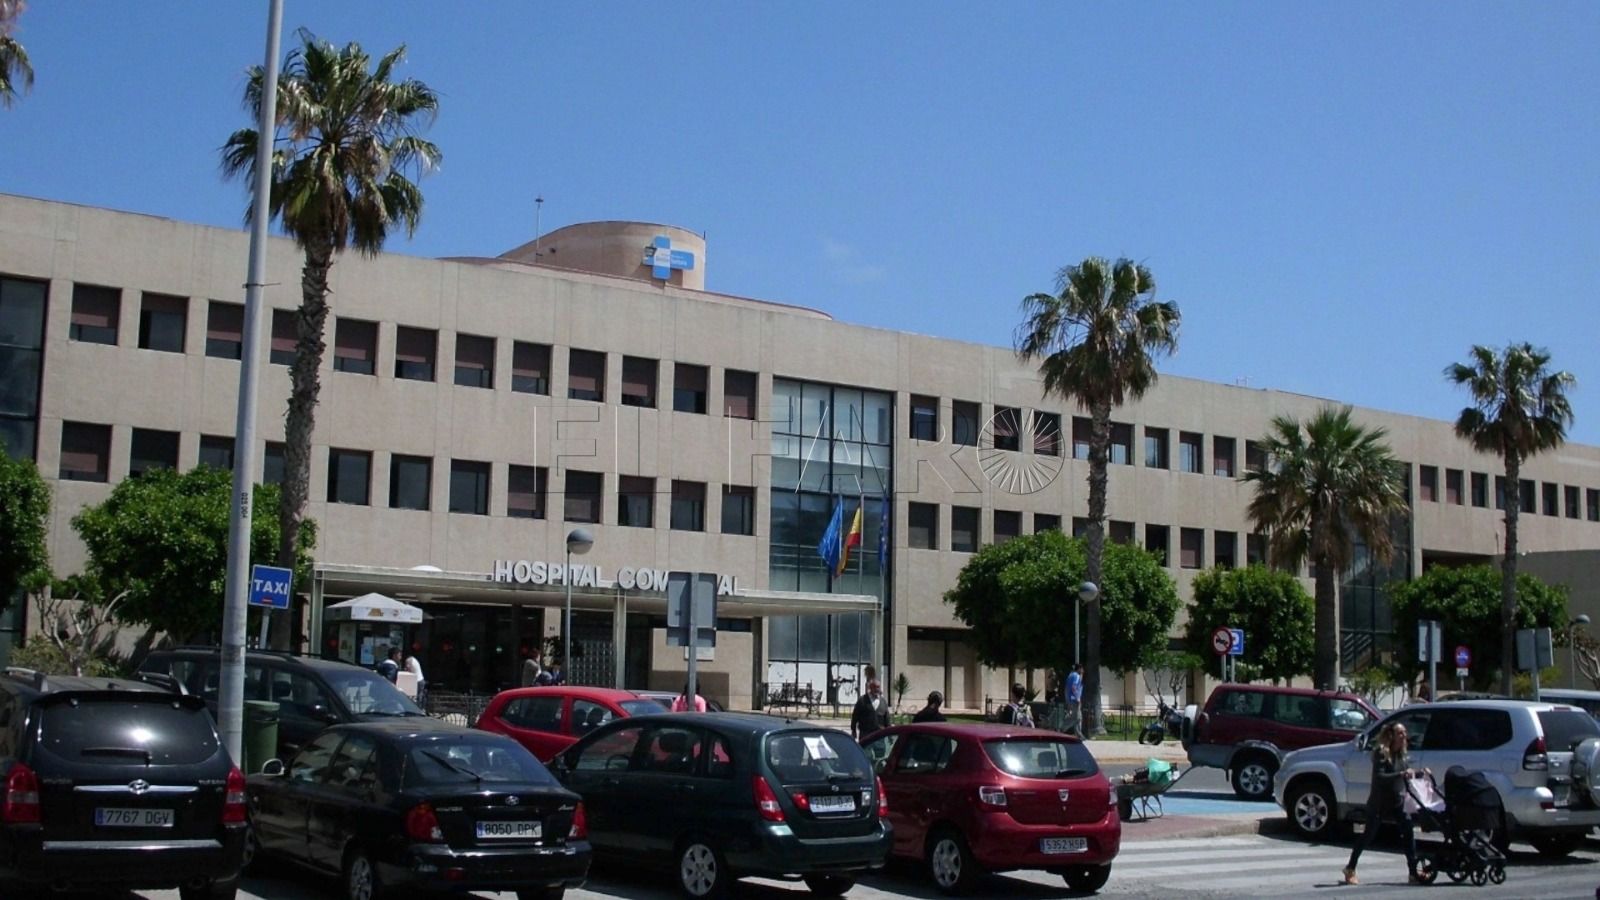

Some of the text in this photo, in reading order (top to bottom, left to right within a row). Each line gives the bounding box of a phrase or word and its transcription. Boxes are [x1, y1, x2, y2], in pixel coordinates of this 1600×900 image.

[494, 560, 745, 596] HOSPITAL COMAL
[254, 579, 288, 595] TAXI
[106, 810, 170, 825] 7767 DGV
[485, 823, 537, 836] 8050 DPK
[1046, 839, 1069, 850] 5352
